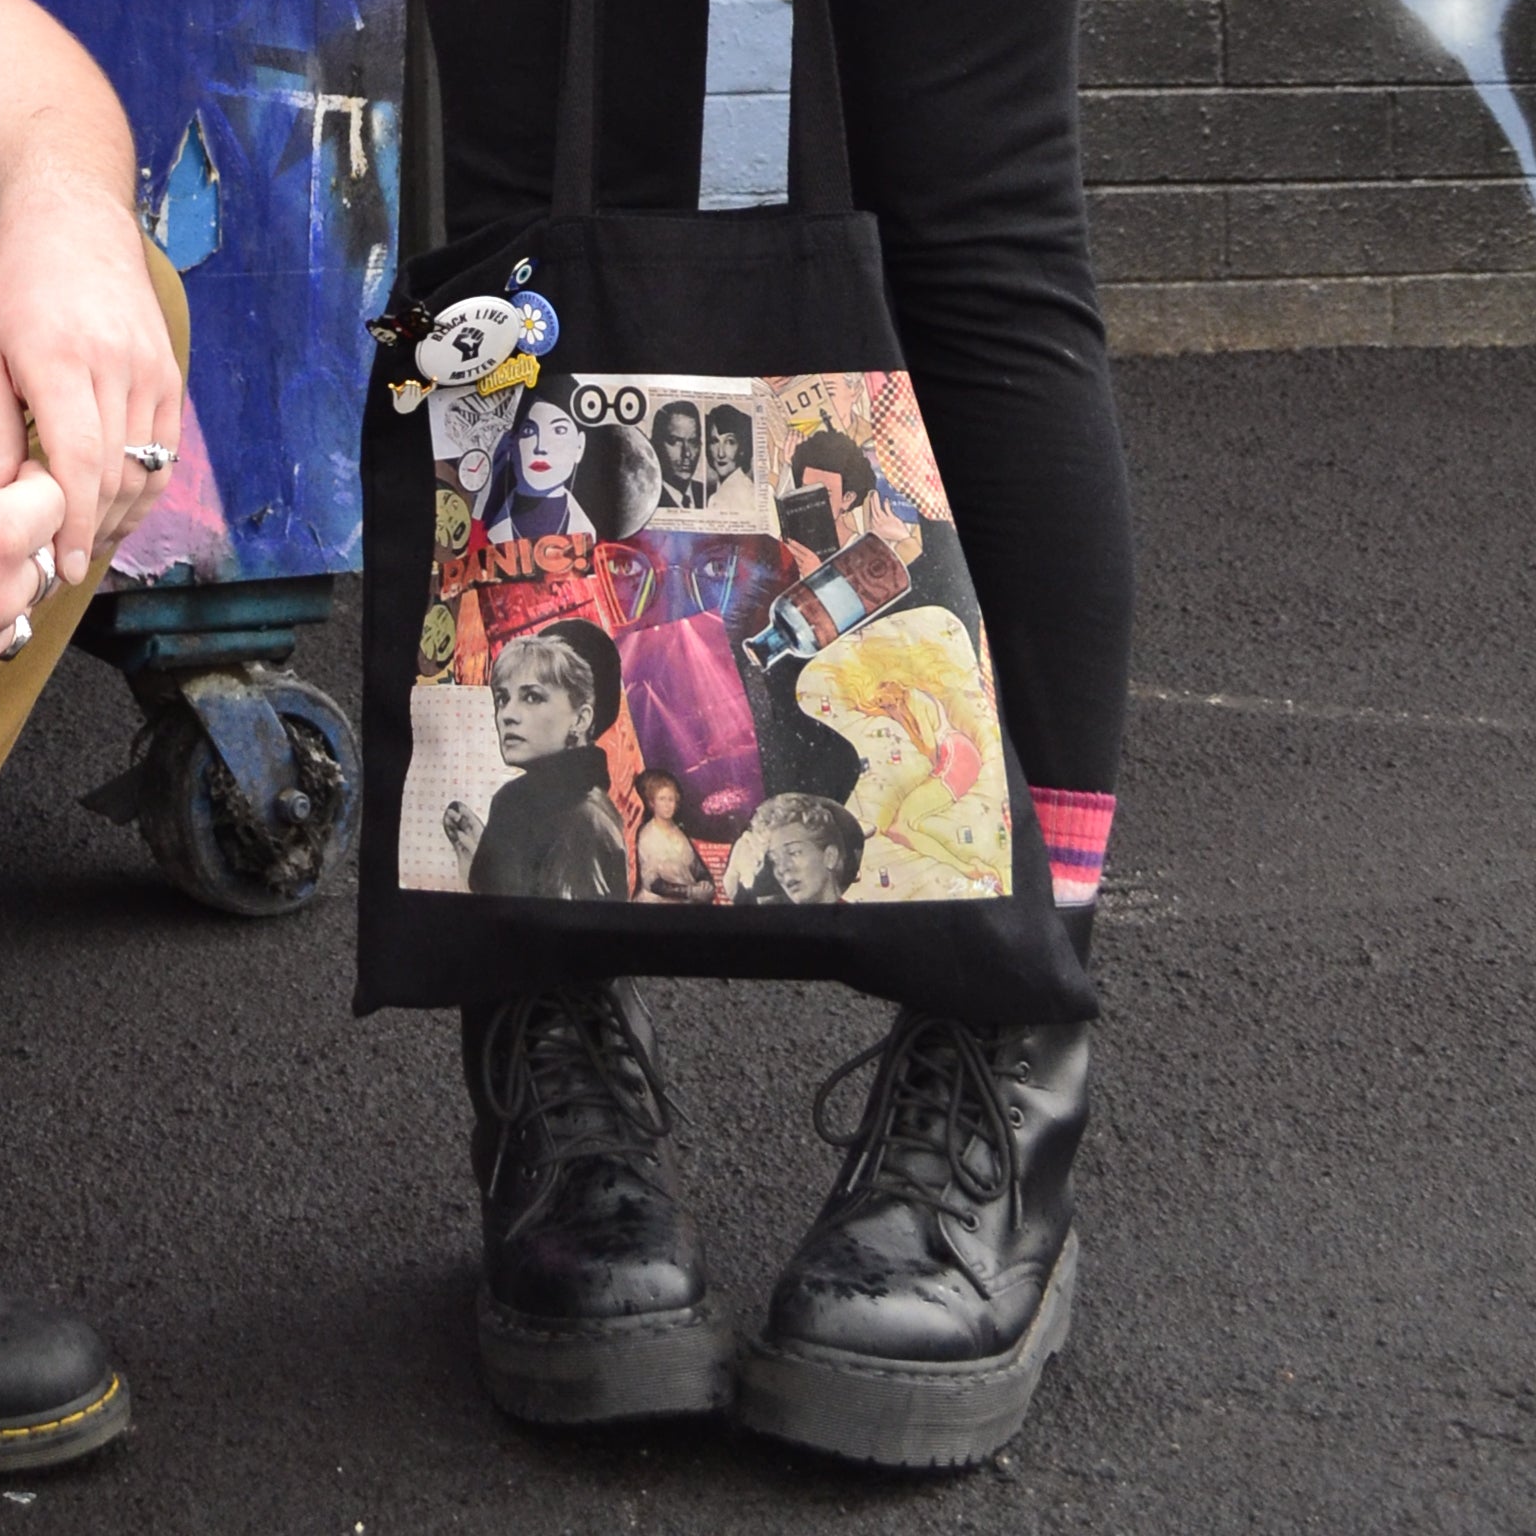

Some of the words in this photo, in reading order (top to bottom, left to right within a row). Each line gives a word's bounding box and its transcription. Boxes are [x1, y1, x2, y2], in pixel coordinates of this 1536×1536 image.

[431, 313, 468, 342] BLACK
[475, 308, 509, 325] LIVES
[449, 358, 497, 380] MATTER
[785, 382, 823, 415] LOT
[441, 532, 592, 596] PANIC!
